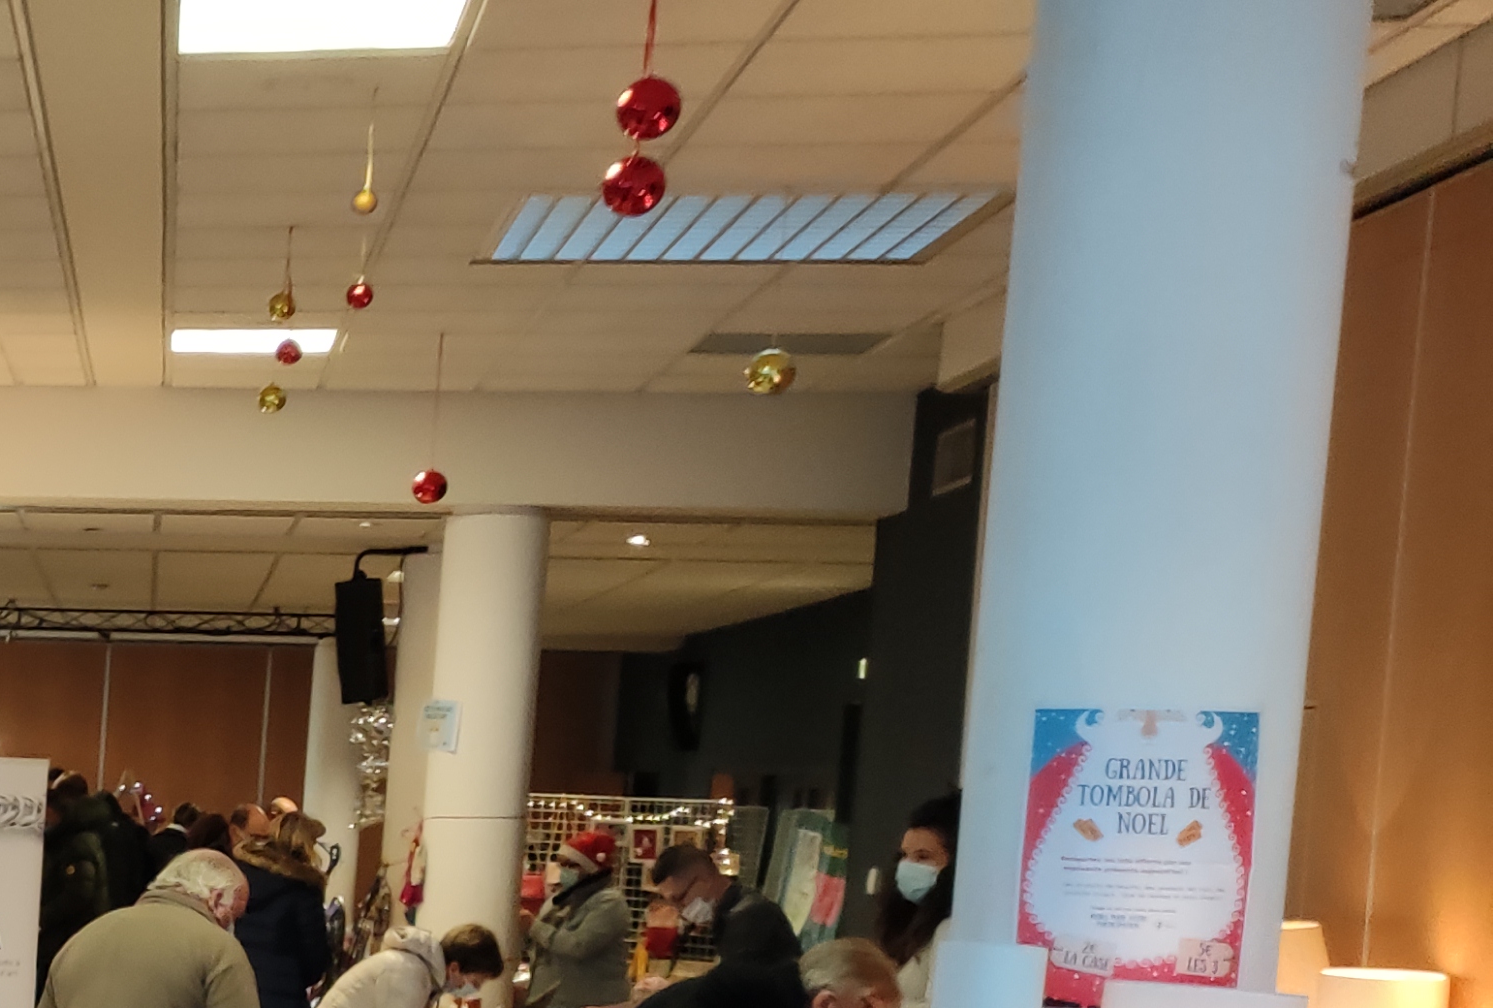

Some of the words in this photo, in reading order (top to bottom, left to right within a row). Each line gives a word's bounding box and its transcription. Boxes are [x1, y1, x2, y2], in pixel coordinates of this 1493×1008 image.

[1105, 758, 1188, 781] GRANDE
[1077, 784, 1175, 808] TOMBOLA
[1188, 787, 1211, 809] DE
[1117, 811, 1169, 835] NOEL
